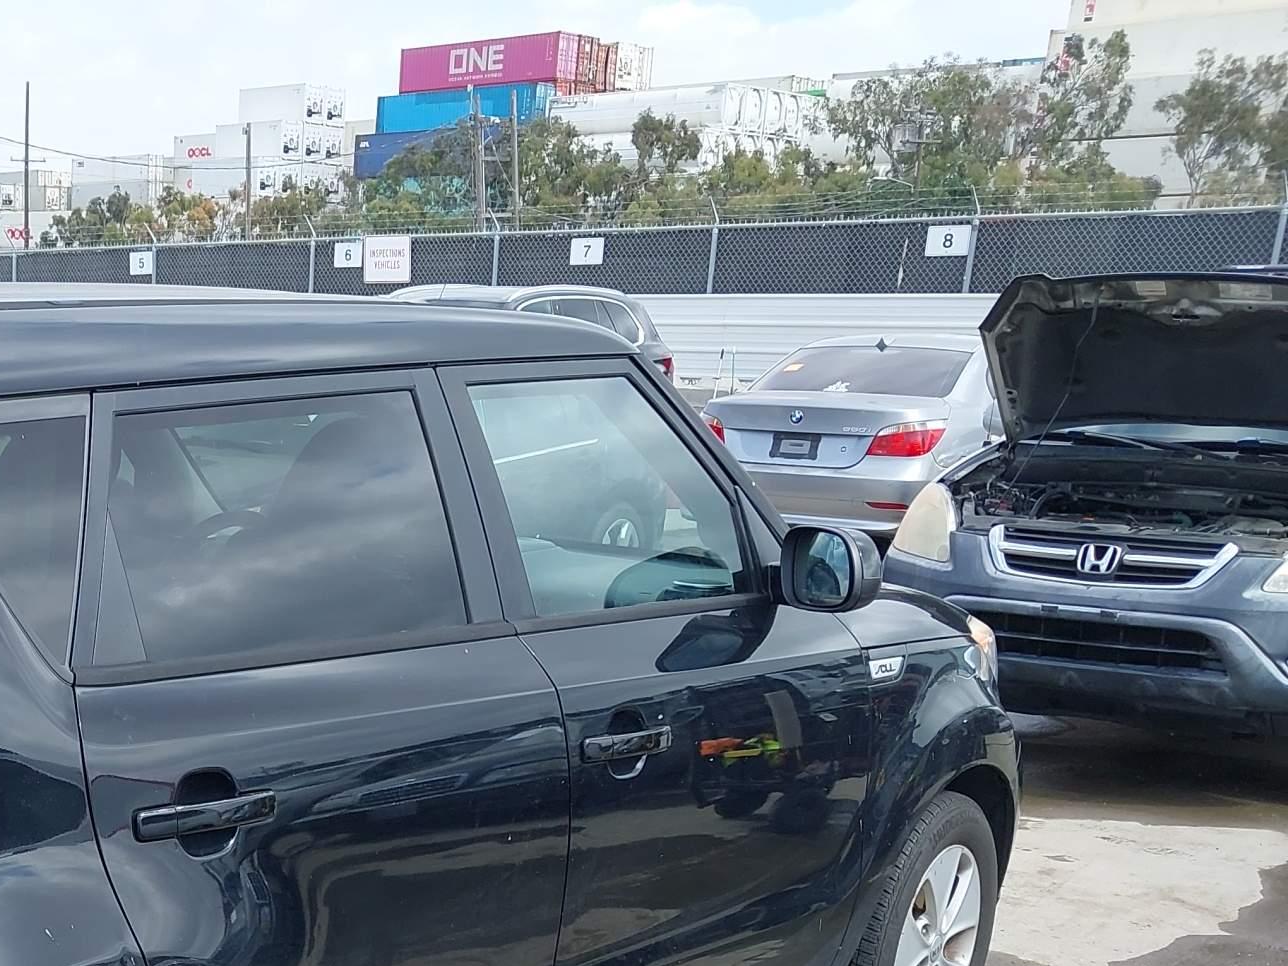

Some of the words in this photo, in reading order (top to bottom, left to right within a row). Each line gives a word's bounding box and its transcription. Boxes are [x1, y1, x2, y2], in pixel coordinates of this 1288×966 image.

[449, 44, 505, 75] ONE
[942, 233, 953, 249] 8
[344, 248, 352, 262] 6
[369, 248, 405, 258] INSPECTIONS
[583, 244, 591, 258] 7
[138, 257, 145, 269] 5
[374, 260, 401, 270] VEHICLES
